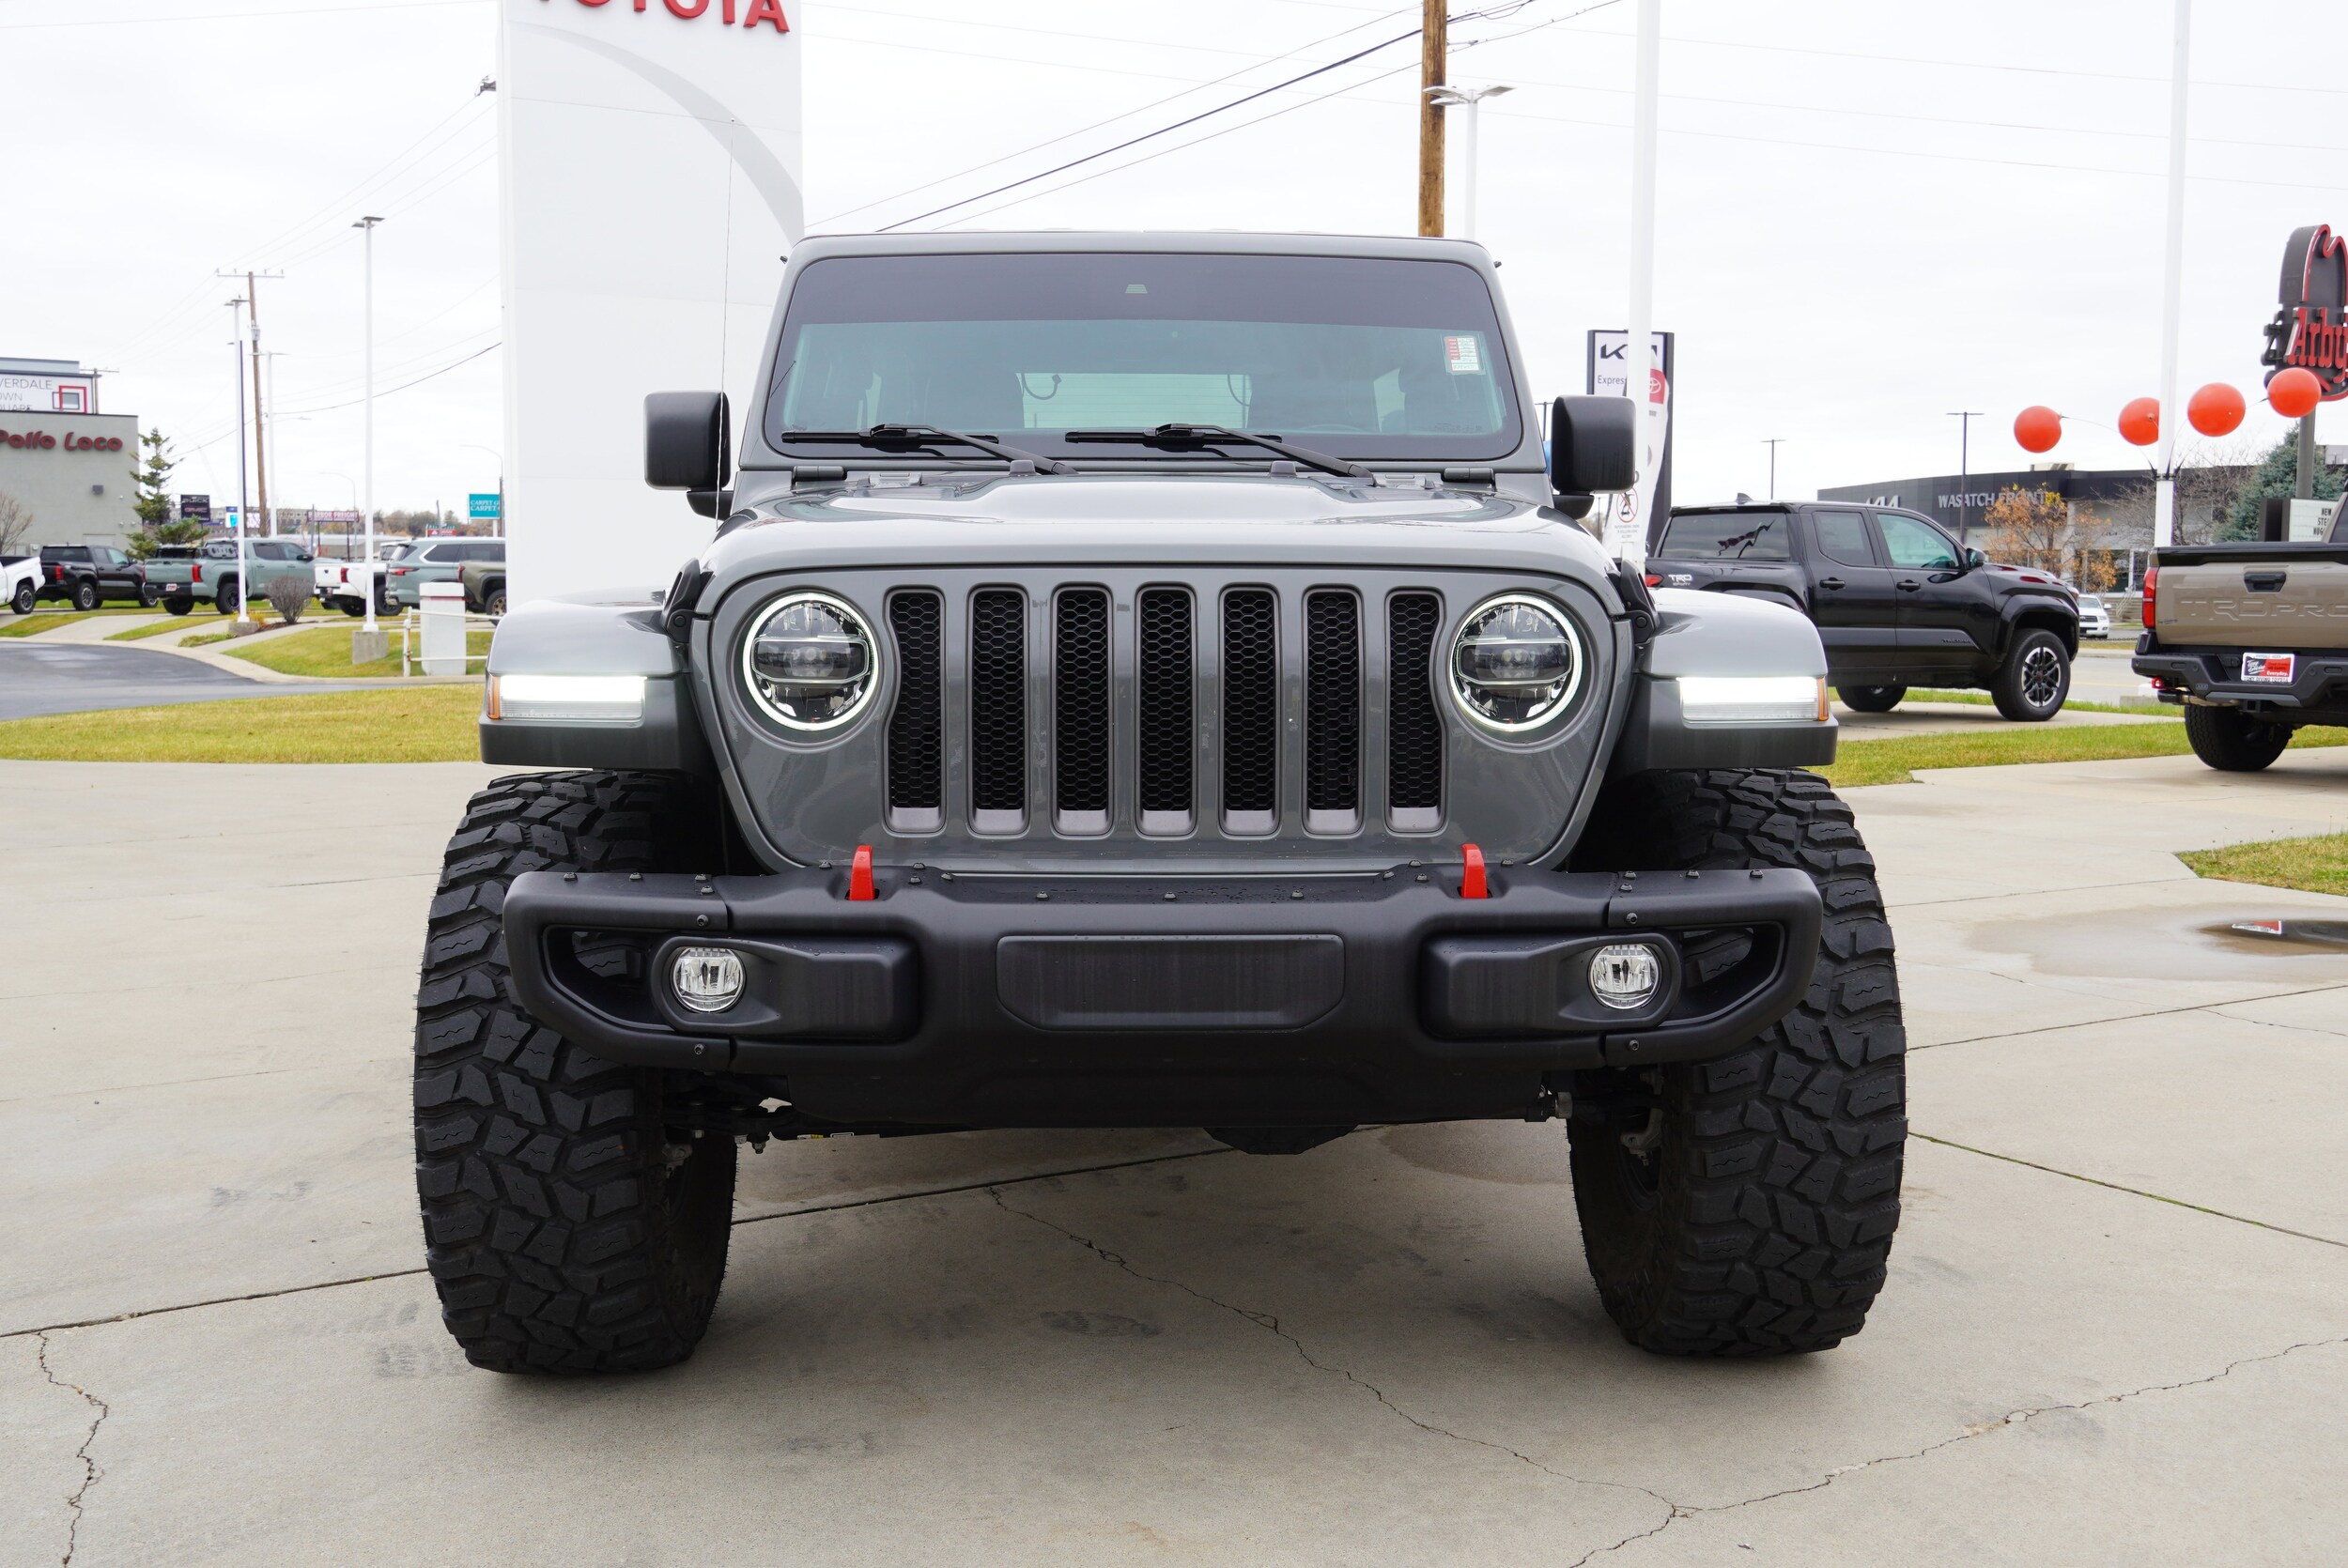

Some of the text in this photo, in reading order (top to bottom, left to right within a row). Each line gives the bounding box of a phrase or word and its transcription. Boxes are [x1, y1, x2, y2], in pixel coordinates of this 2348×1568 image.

[0, 378, 53, 390] ERDALE
[1598, 376, 1627, 386] Expres
[64, 432, 123, 451] Loco
[1938, 493, 1995, 508] WASATCH
[2180, 599, 2268, 621] TRD
